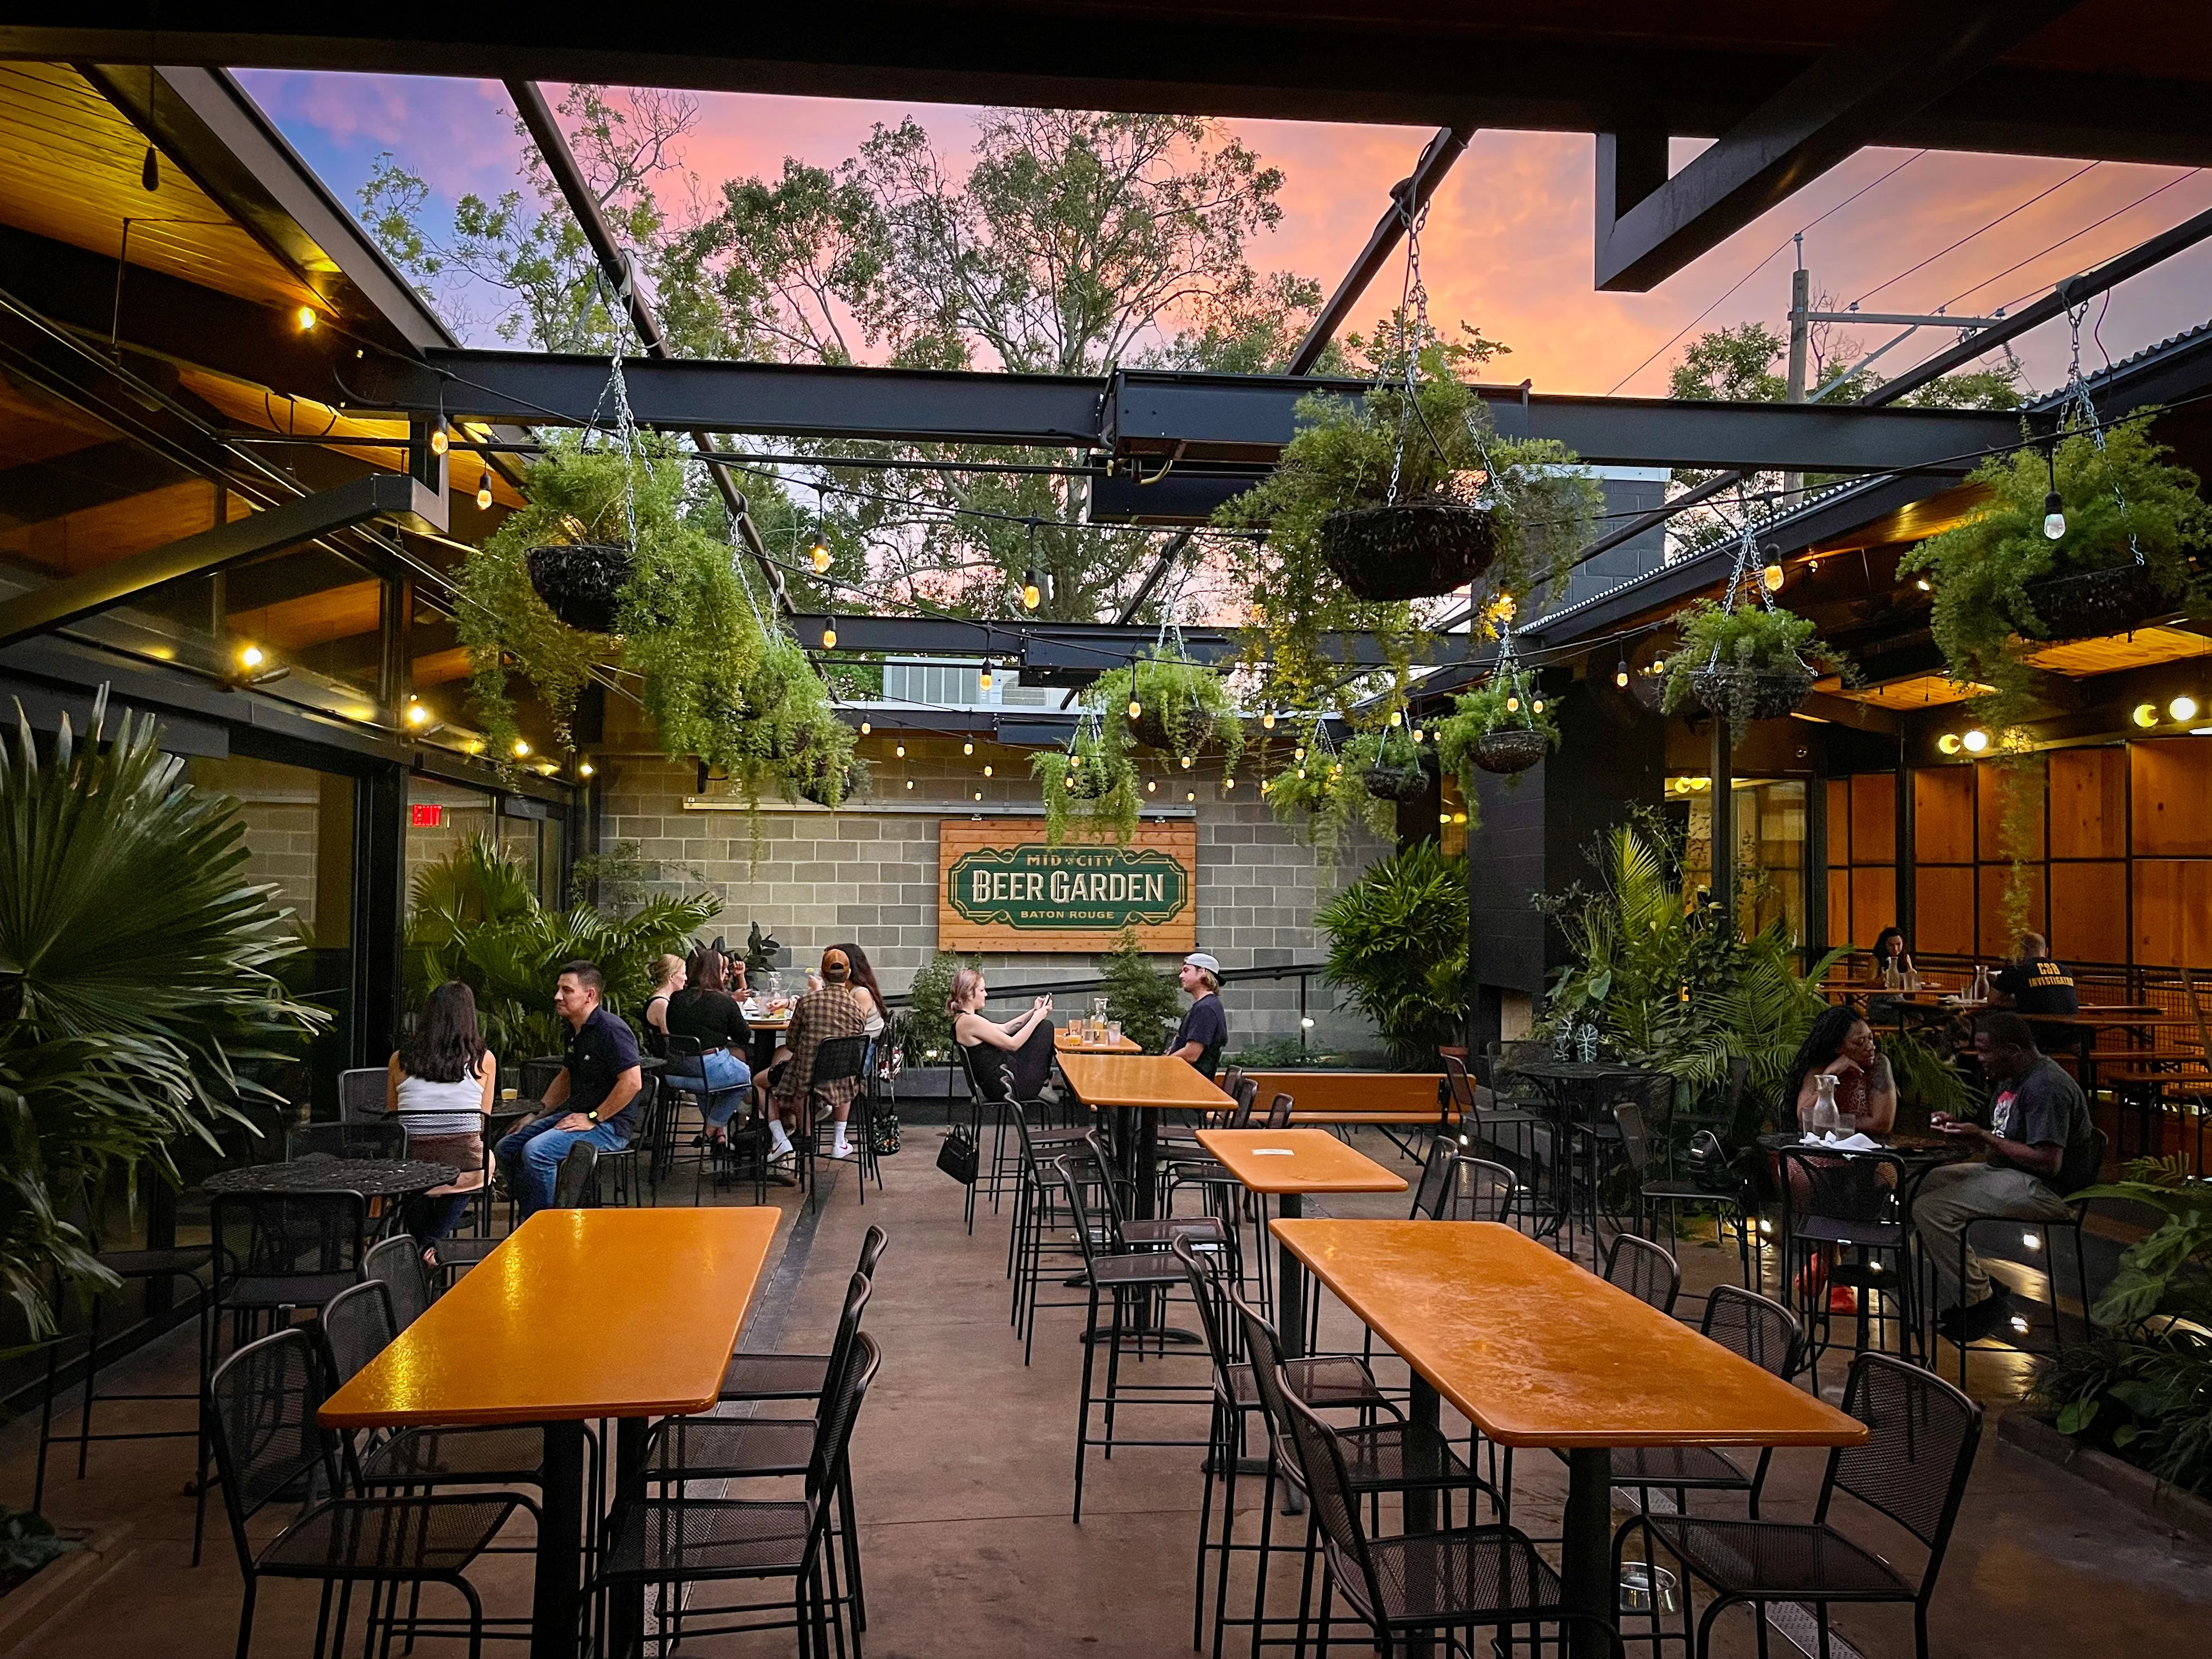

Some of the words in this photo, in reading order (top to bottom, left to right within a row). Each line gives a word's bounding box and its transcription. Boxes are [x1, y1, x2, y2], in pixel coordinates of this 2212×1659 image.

[413, 805, 442, 827] EXIT
[1026, 854, 1062, 867] MID
[1076, 855, 1115, 867] CITY
[972, 869, 1044, 904] BEER
[1050, 870, 1164, 904] GARDEN
[1021, 911, 1064, 919] BATON
[1069, 911, 1115, 920] ROUGE
[2029, 976, 2074, 988] INVESTIGATOR
